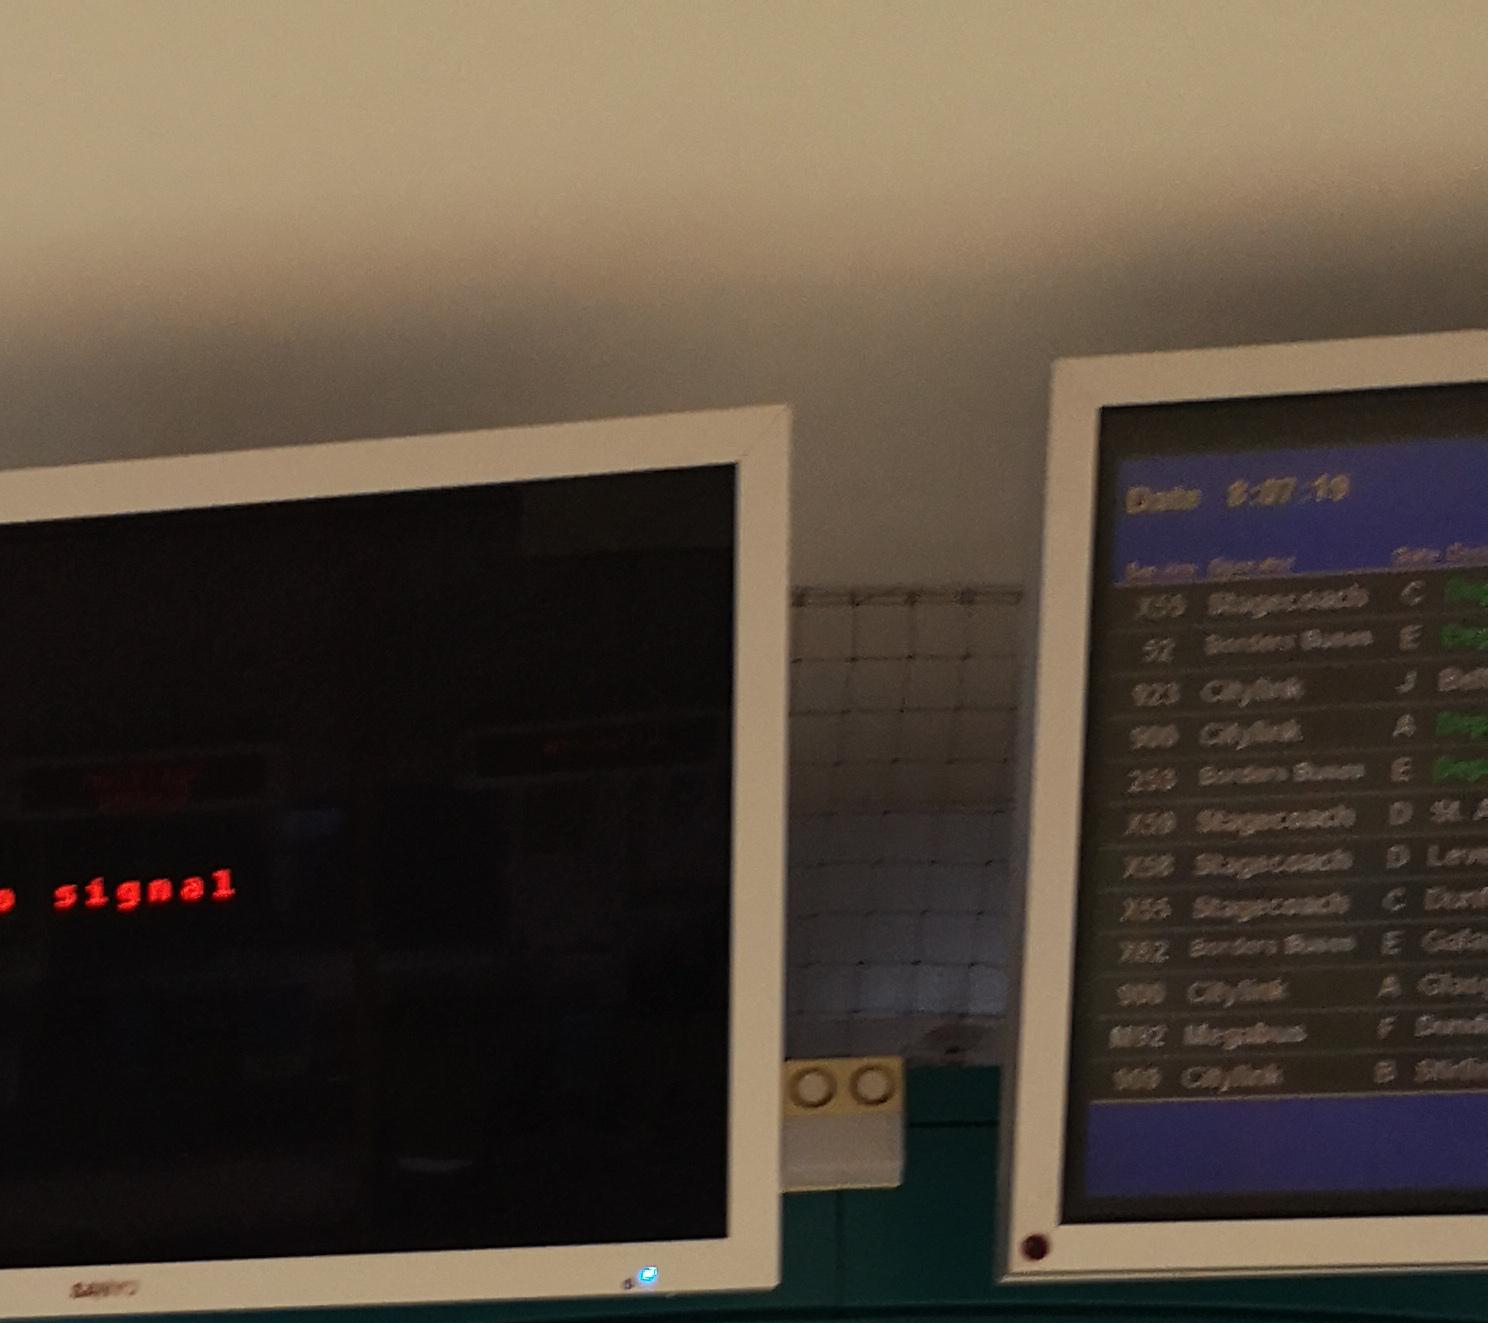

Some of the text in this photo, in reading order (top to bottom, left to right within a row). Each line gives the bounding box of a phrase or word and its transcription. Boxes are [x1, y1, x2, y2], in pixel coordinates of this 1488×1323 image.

[1399, 624, 1424, 650] E
[1395, 670, 1417, 694] J
[1392, 713, 1416, 738] A
[1390, 757, 1412, 783] E
[52, 868, 236, 911] signal
[1381, 887, 1407, 912] C
[1381, 930, 1407, 956] E
[1377, 975, 1403, 999] A
[1377, 1016, 1400, 1040] F
